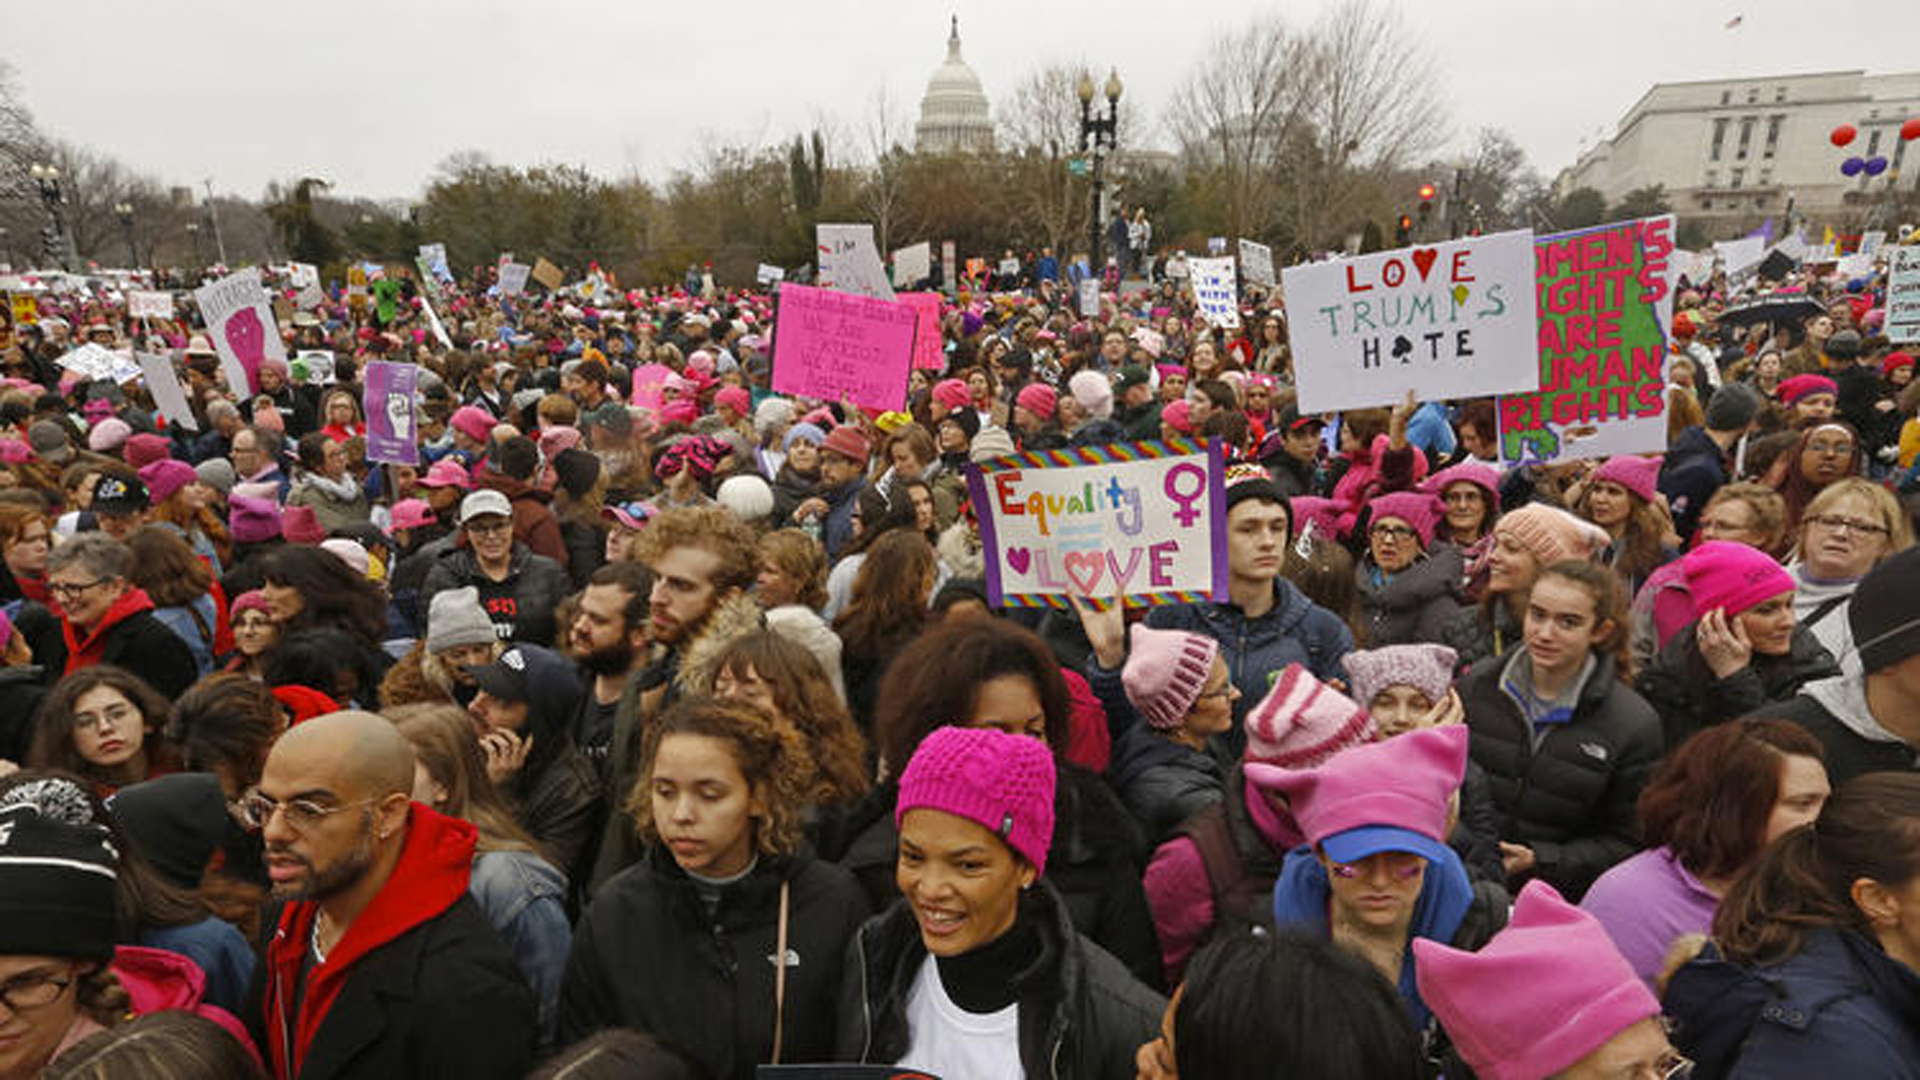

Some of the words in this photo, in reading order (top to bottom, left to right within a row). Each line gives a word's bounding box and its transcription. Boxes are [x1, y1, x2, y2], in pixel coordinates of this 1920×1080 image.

[1535, 262, 1669, 318] IGHTS
[1539, 309, 1623, 354] ARE
[1540, 345, 1664, 393] UMAN
[1501, 382, 1665, 434] RIGHTS
[995, 470, 1143, 536] Equality
